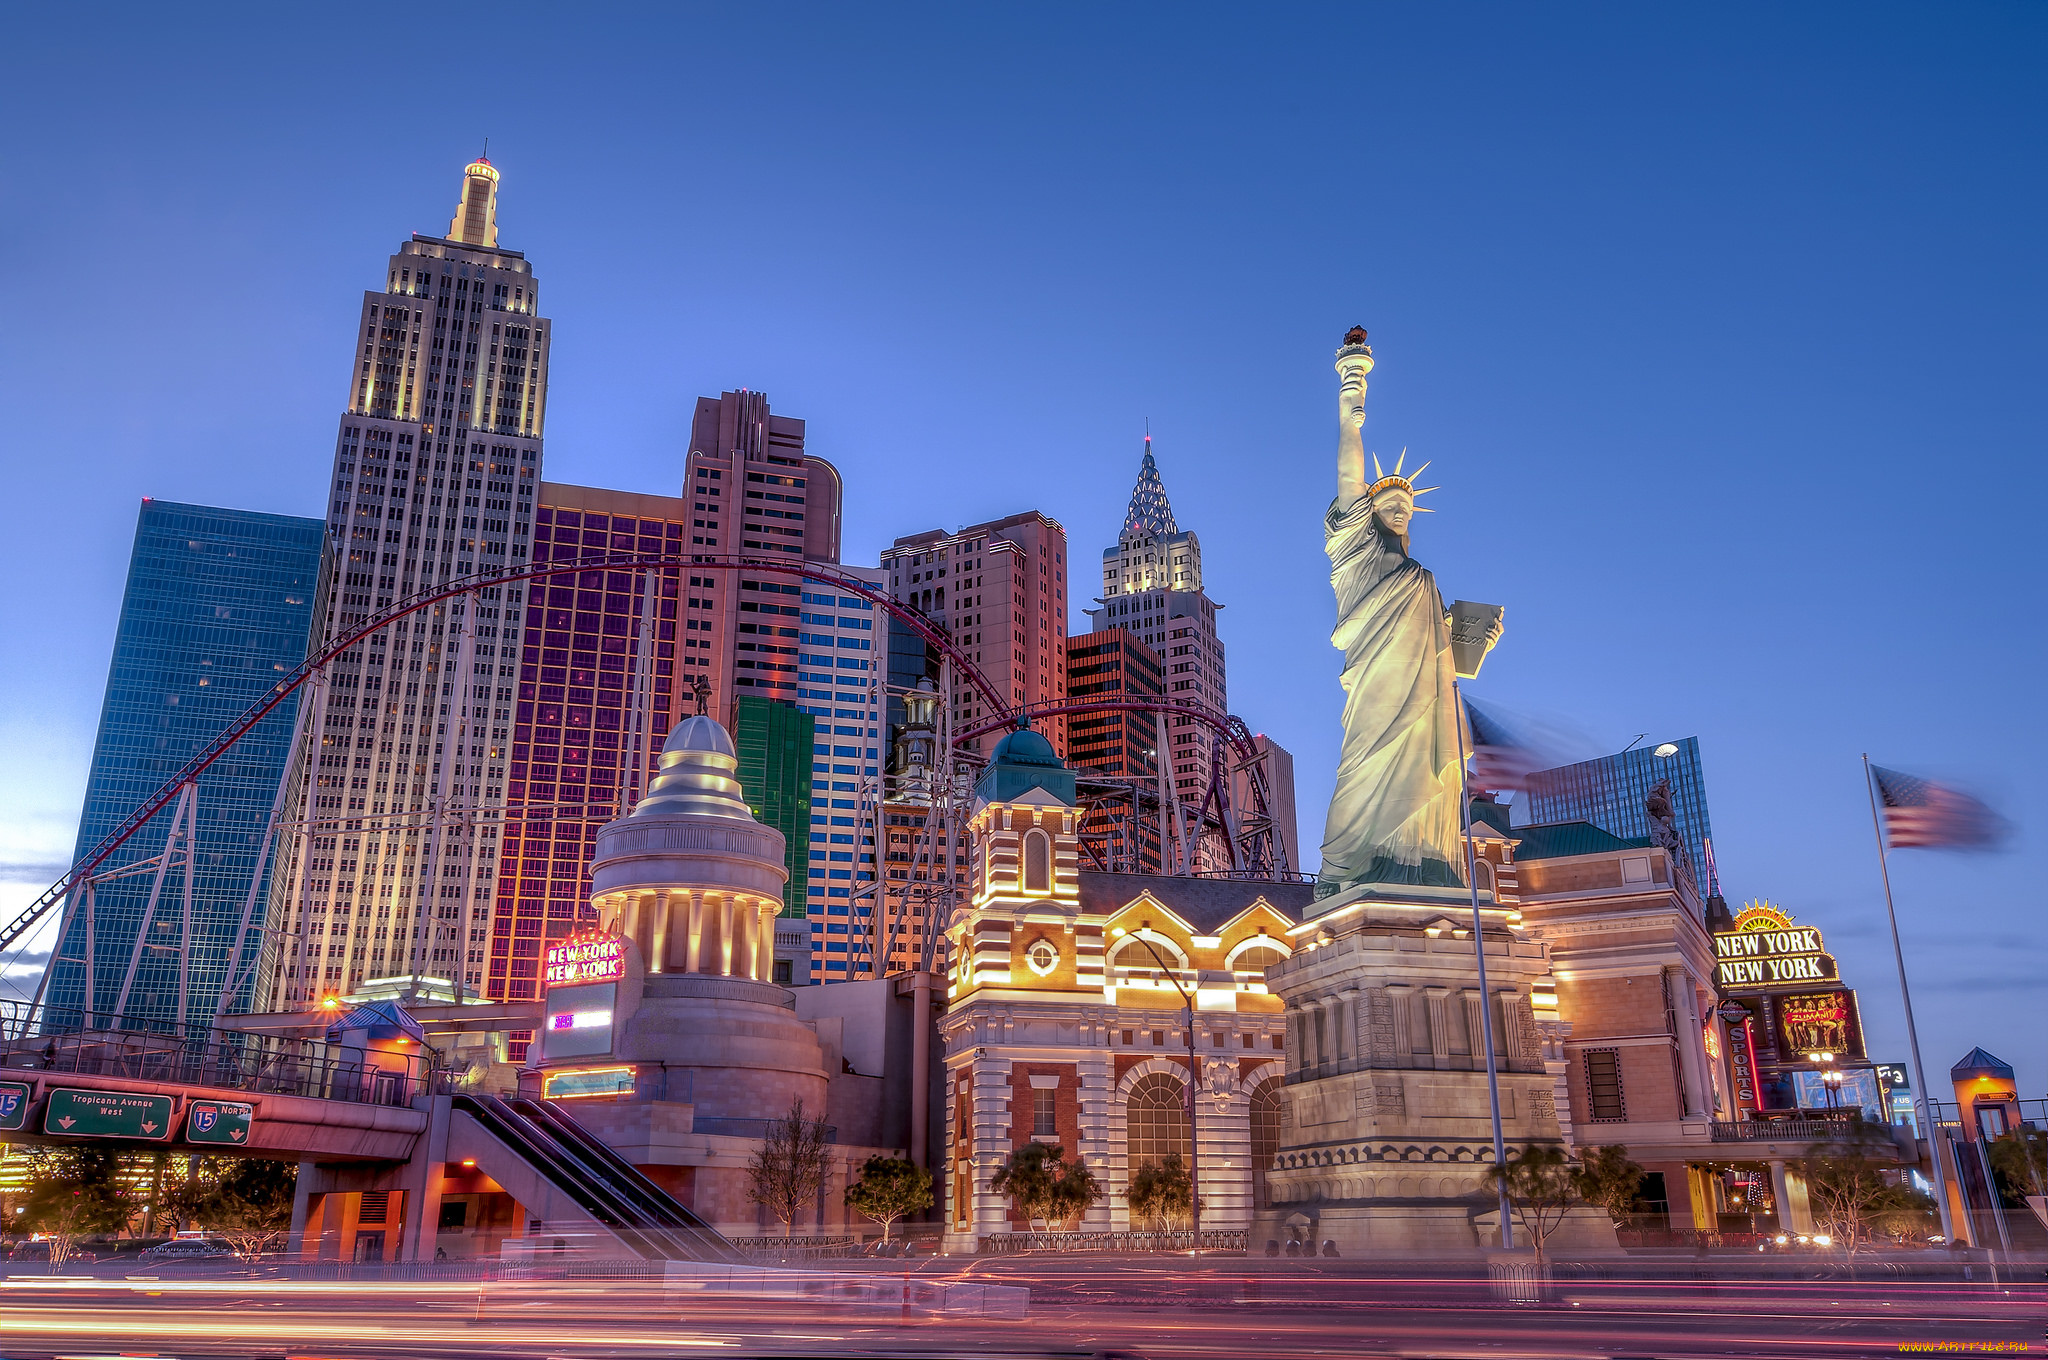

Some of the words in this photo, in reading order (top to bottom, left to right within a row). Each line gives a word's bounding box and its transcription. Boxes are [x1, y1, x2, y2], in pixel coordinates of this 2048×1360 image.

[1715, 934, 1760, 957] NEW
[1762, 930, 1820, 953] YORK
[548, 946, 579, 964] NEW
[582, 941, 619, 960] YORK
[547, 963, 578, 981] NEW
[581, 959, 619, 978] YORK
[1719, 960, 1764, 983] NEW
[1767, 956, 1824, 980] YORK
[1791, 1009, 1838, 1021] ZUMANITY
[1729, 1027, 1754, 1100] SPORTS
[0, 1095, 18, 1111] 15
[72, 1094, 117, 1105] Tropicana
[120, 1098, 153, 1107] Avenue
[100, 1107, 123, 1116] West
[221, 1105, 249, 1115] NORTH
[198, 1112, 213, 1127] 15
